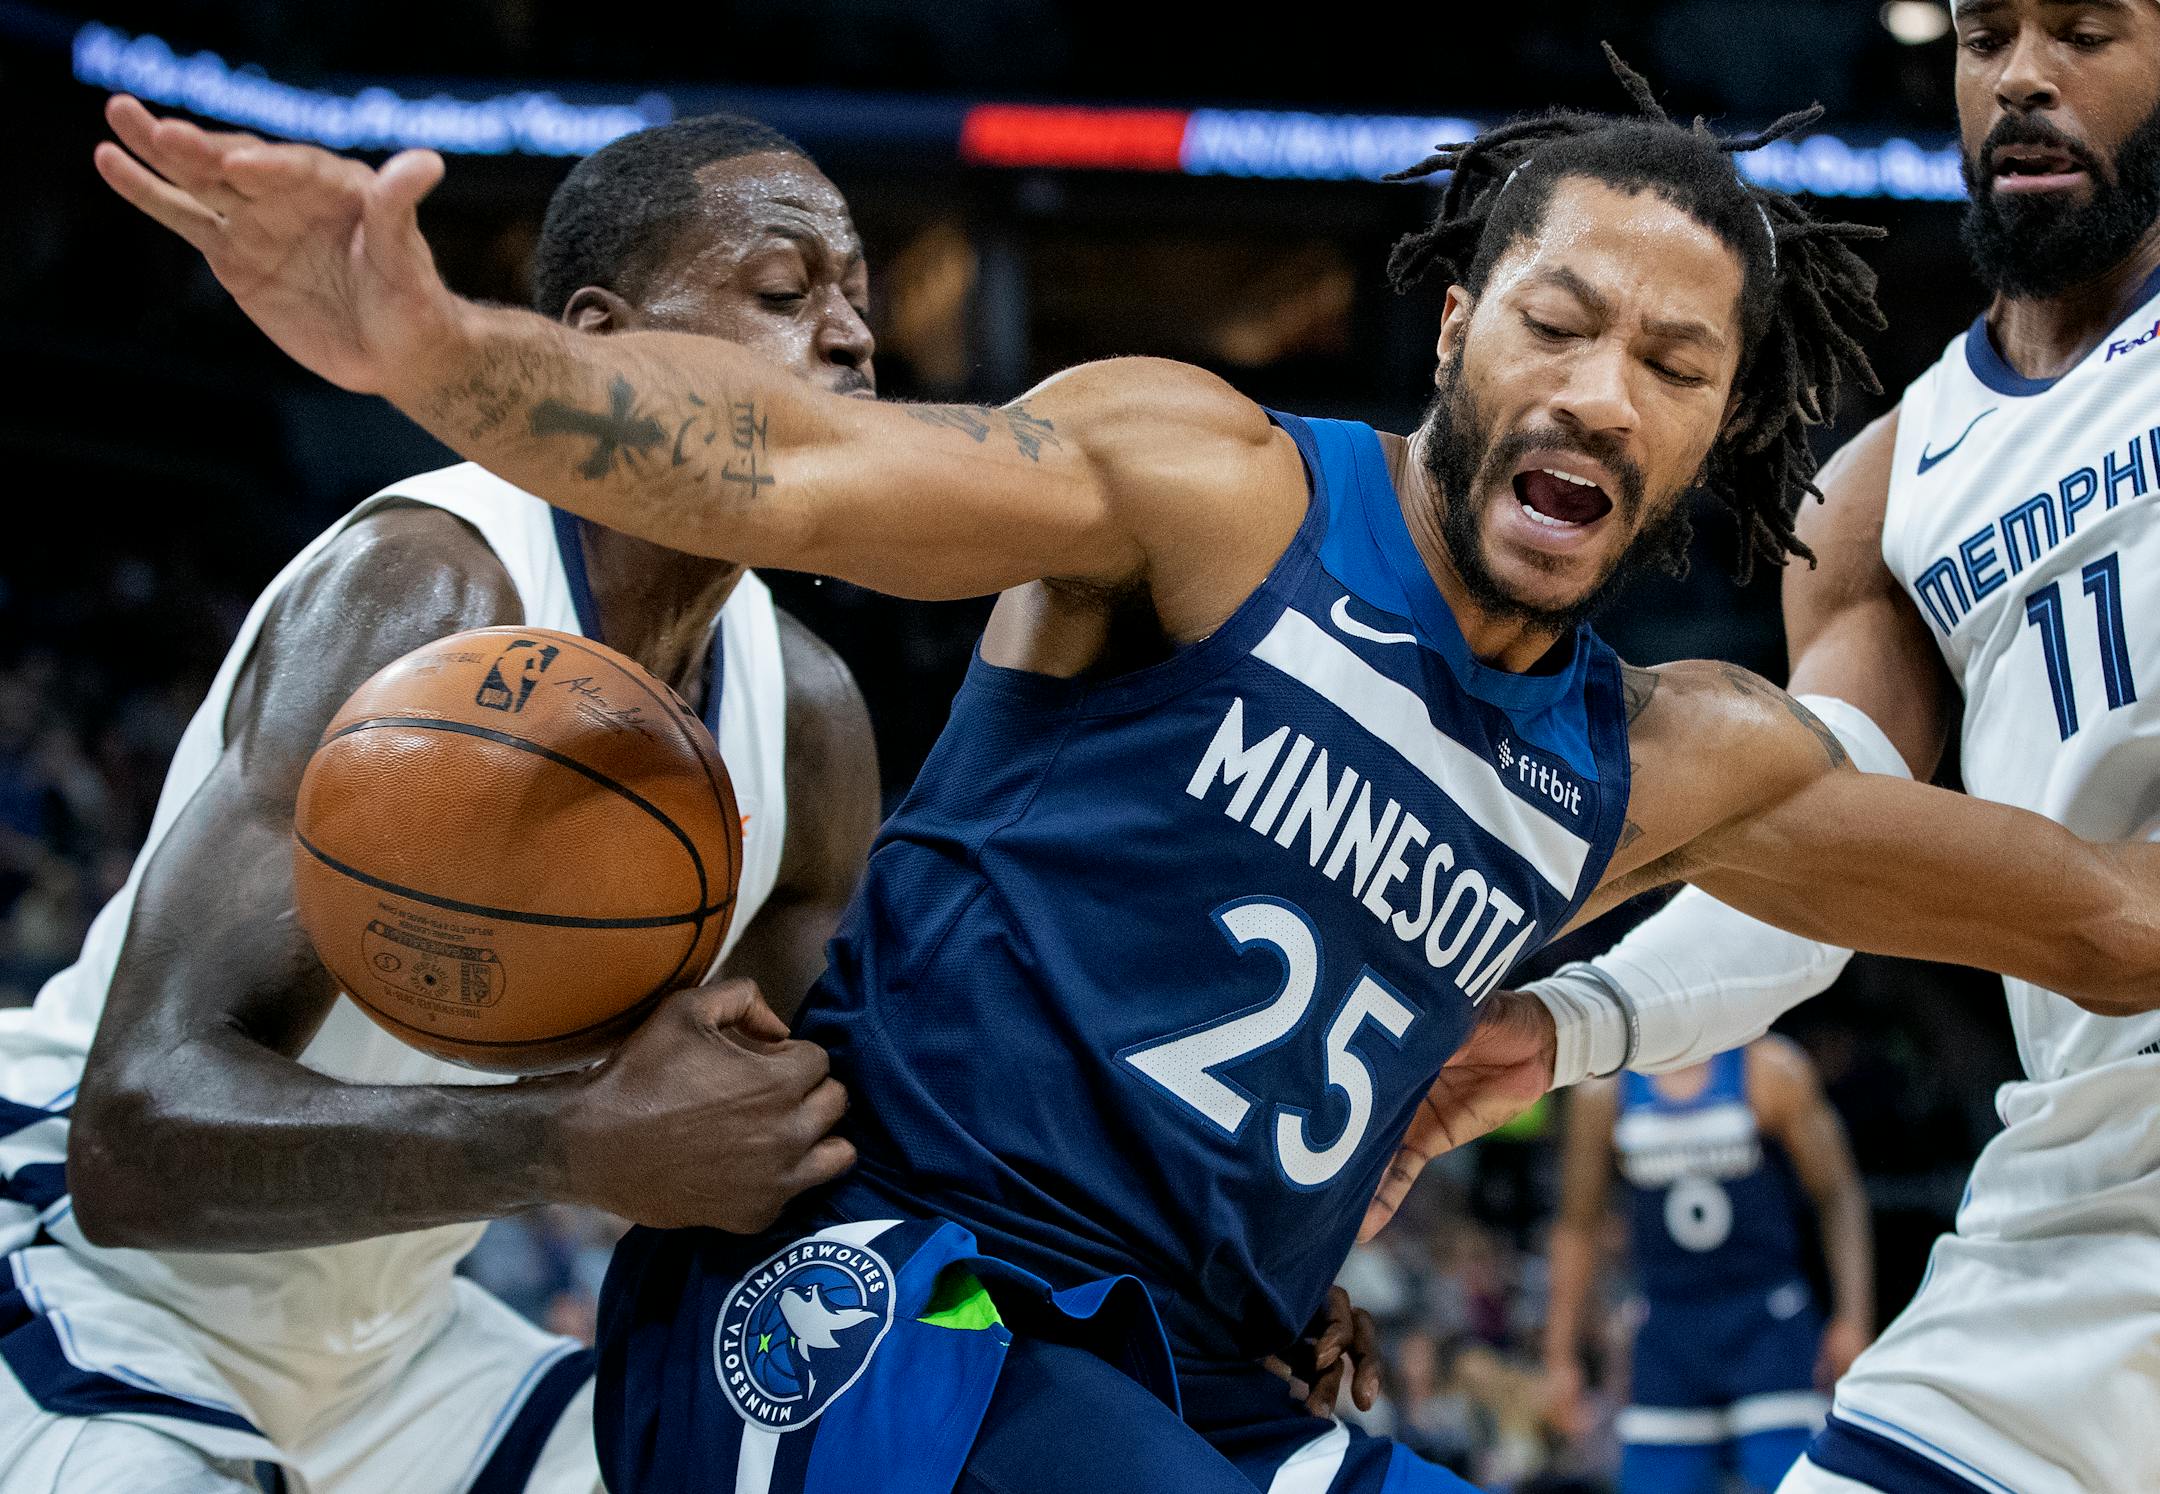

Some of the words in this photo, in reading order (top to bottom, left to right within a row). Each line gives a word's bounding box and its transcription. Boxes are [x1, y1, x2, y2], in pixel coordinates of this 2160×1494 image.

[2025, 551, 2138, 743] 11
[1518, 754, 1582, 816] fitbit
[1185, 696, 1537, 1007] MINNESOTA
[1114, 895, 1425, 1192] 25
[1664, 1178, 1732, 1251] 0
[735, 1245, 885, 1309] TIMBERWOLVES
[723, 1322, 793, 1422] MINNESOTA
